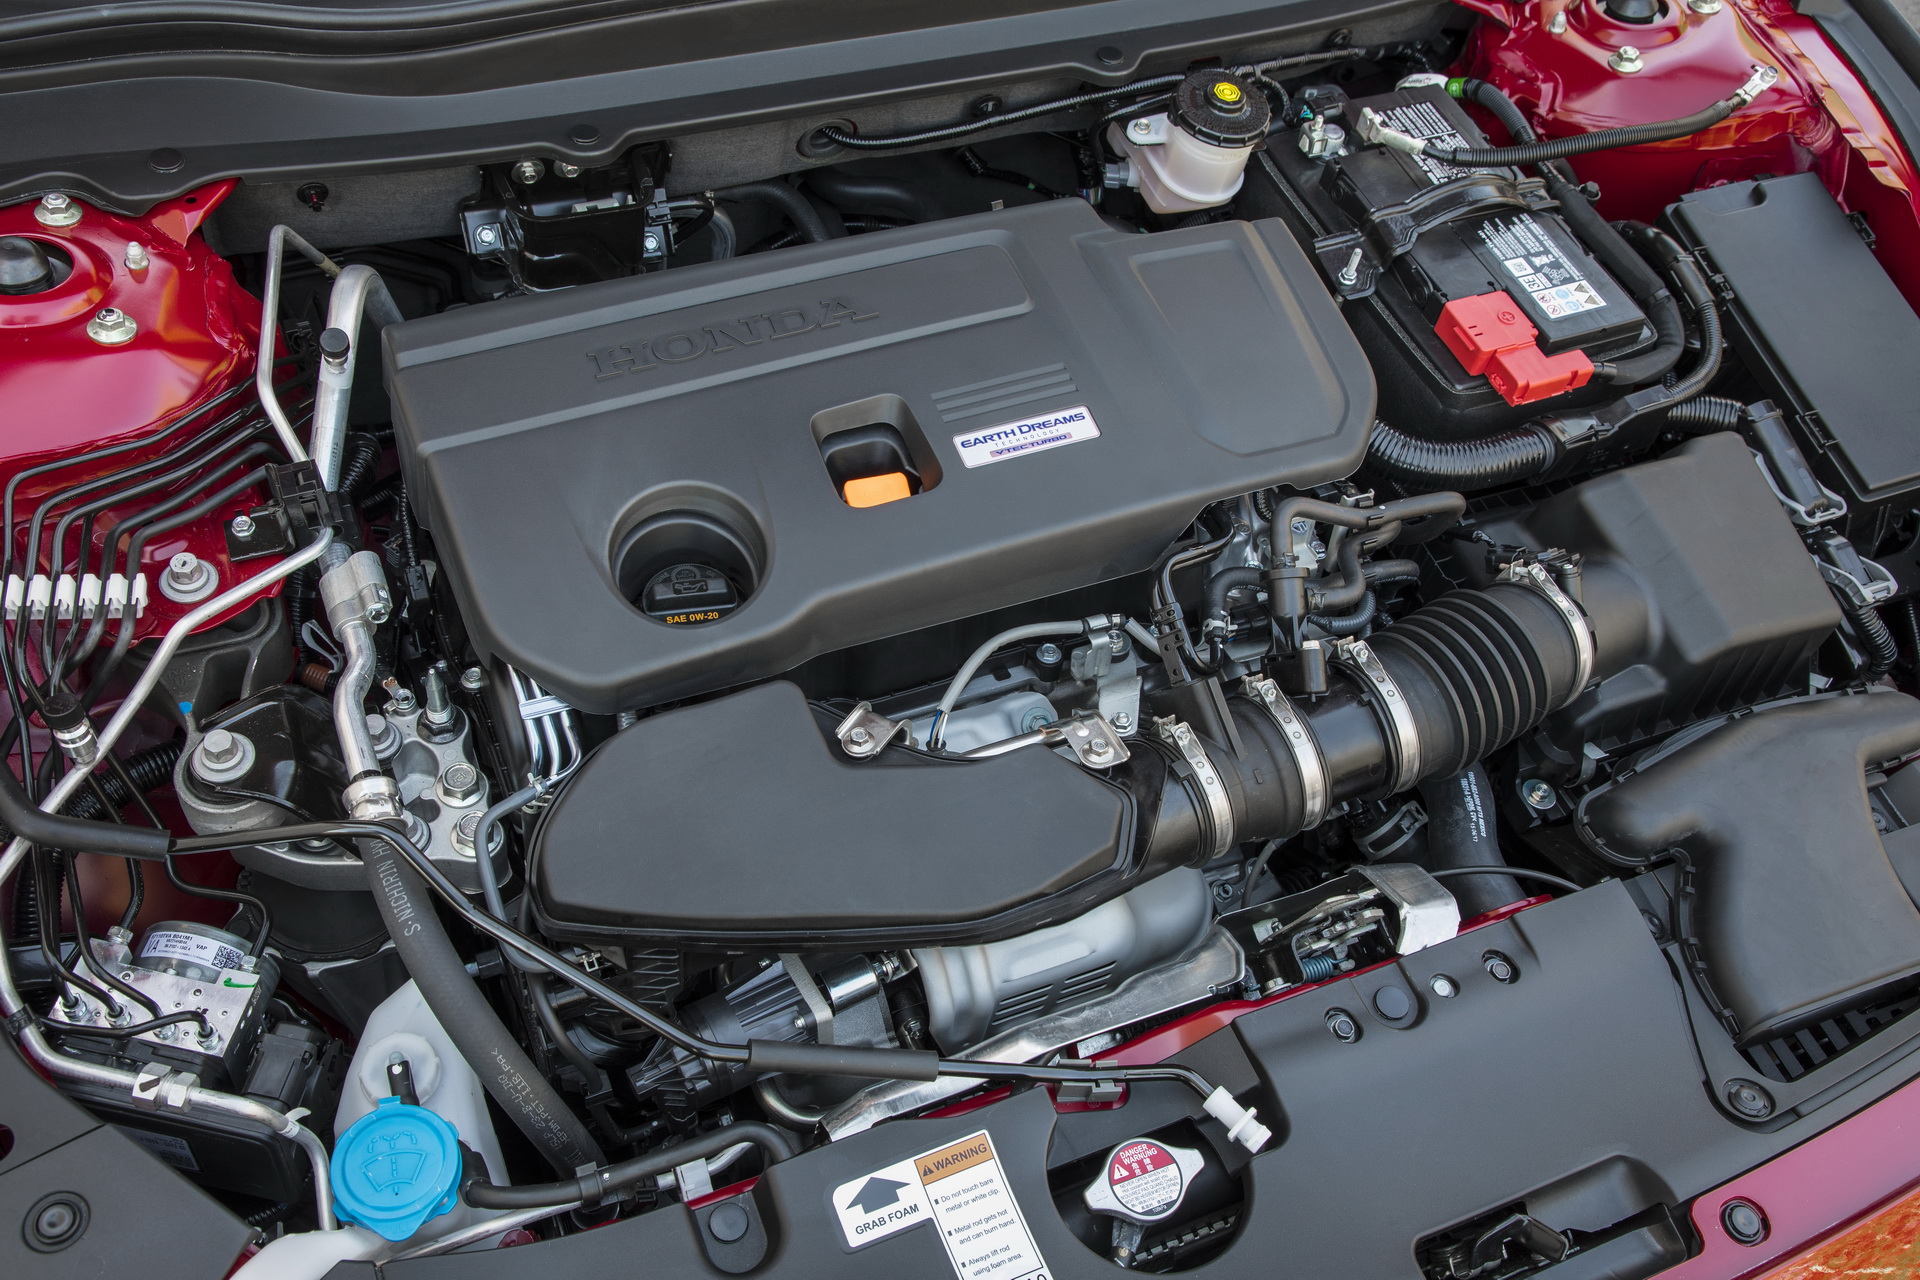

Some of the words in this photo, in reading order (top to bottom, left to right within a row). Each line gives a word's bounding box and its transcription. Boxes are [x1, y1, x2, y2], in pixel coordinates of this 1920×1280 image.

[586, 297, 879, 379] HONDA
[960, 428, 1016, 448] EARTH
[1017, 412, 1086, 434] DREAMS
[995, 429, 1060, 448] TECHNOLOGY
[995, 444, 1028, 455] VTEC
[1028, 434, 1068, 447] TURBO
[666, 614, 687, 624] SAE
[689, 611, 719, 622] 0W-20
[196, 943, 208, 951] VAP
[933, 1143, 987, 1171] WARNING
[1120, 1144, 1148, 1159] DANGER
[1123, 1148, 1157, 1165] WARNUNG
[951, 1190, 961, 1198] not
[962, 1184, 979, 1194] touch
[979, 1178, 993, 1187] bare
[1120, 1180, 1134, 1188] NEVER
[945, 1202, 963, 1213] metal
[971, 1193, 987, 1203] white
[988, 1188, 1000, 1196] clip.
[855, 1216, 887, 1235] GRAB
[888, 1203, 920, 1222] FOAM
[954, 1223, 972, 1234] Metal
[972, 1219, 983, 1227] rod
[984, 1213, 997, 1224] gets
[997, 1209, 1008, 1217] hot
[959, 1236, 971, 1244] and
[999, 1218, 1016, 1229] hand.
[968, 1254, 991, 1266] Always
[1000, 1244, 1010, 1253] rod
[973, 1266, 990, 1276] using
[990, 1259, 1006, 1269] foam
[1007, 1253, 1023, 1262] area.
